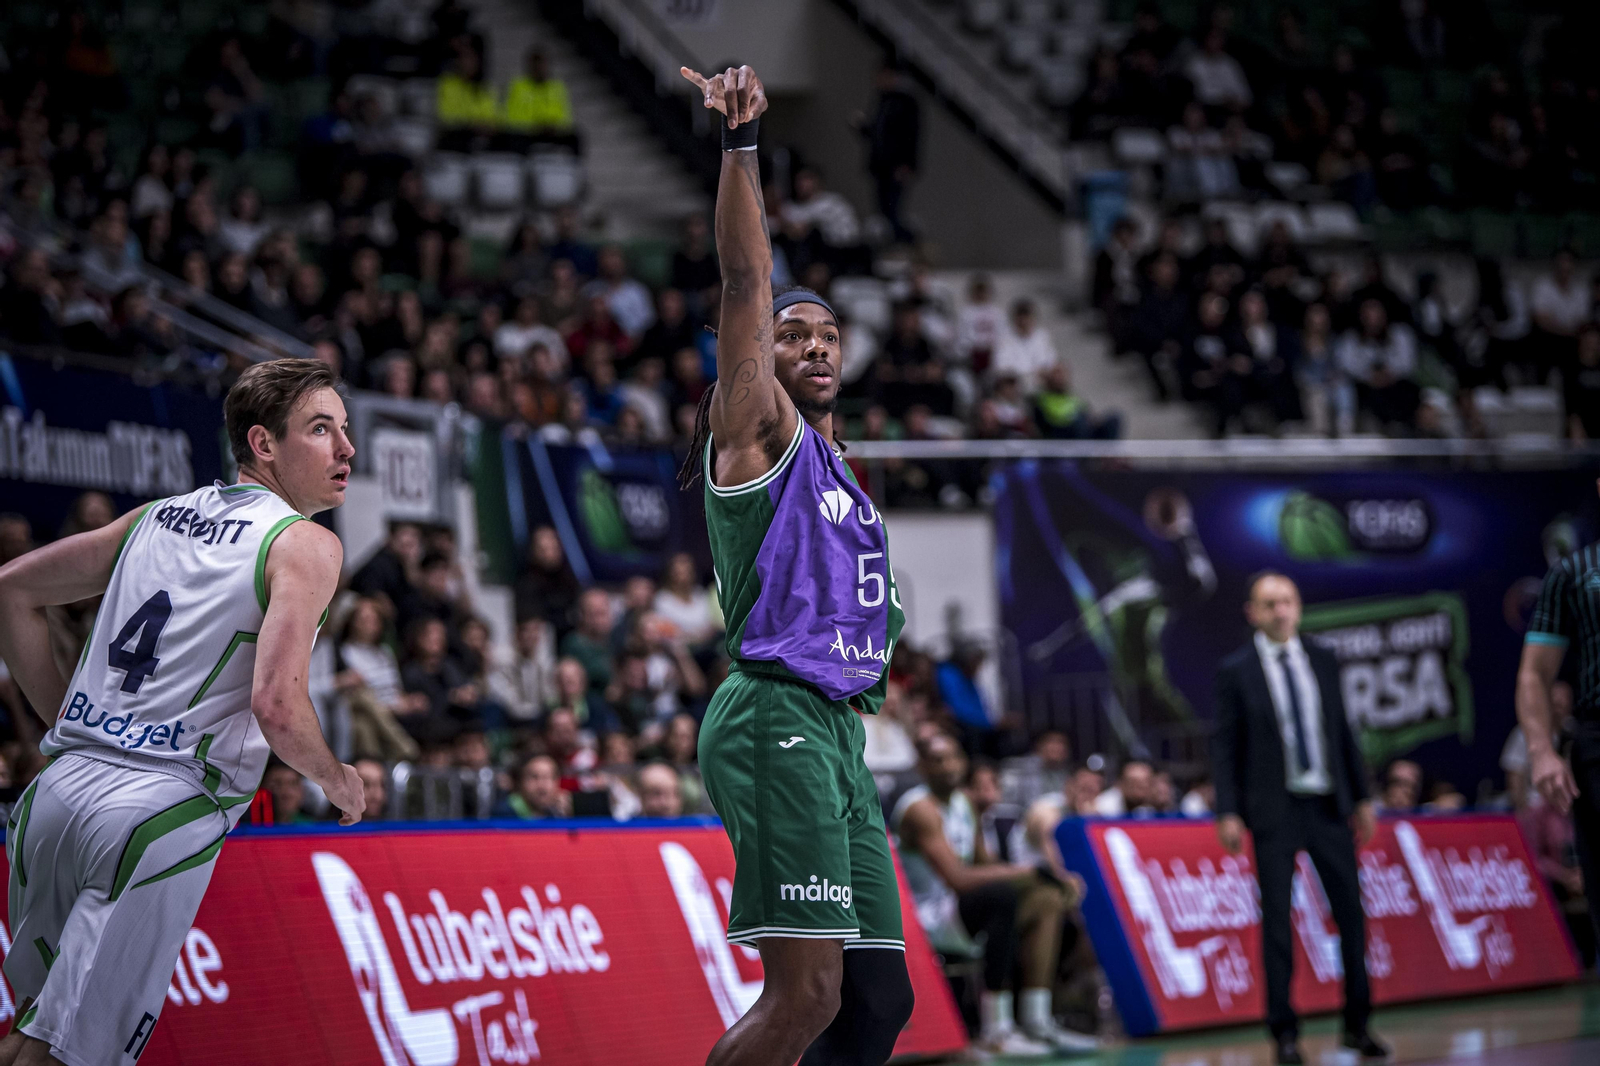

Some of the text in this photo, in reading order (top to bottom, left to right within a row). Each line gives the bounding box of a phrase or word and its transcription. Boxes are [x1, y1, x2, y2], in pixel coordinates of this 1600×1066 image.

[108, 590, 173, 695] 4
[828, 628, 894, 664] Andal
[64, 691, 185, 751] Budget
[1340, 648, 1453, 728] RSA
